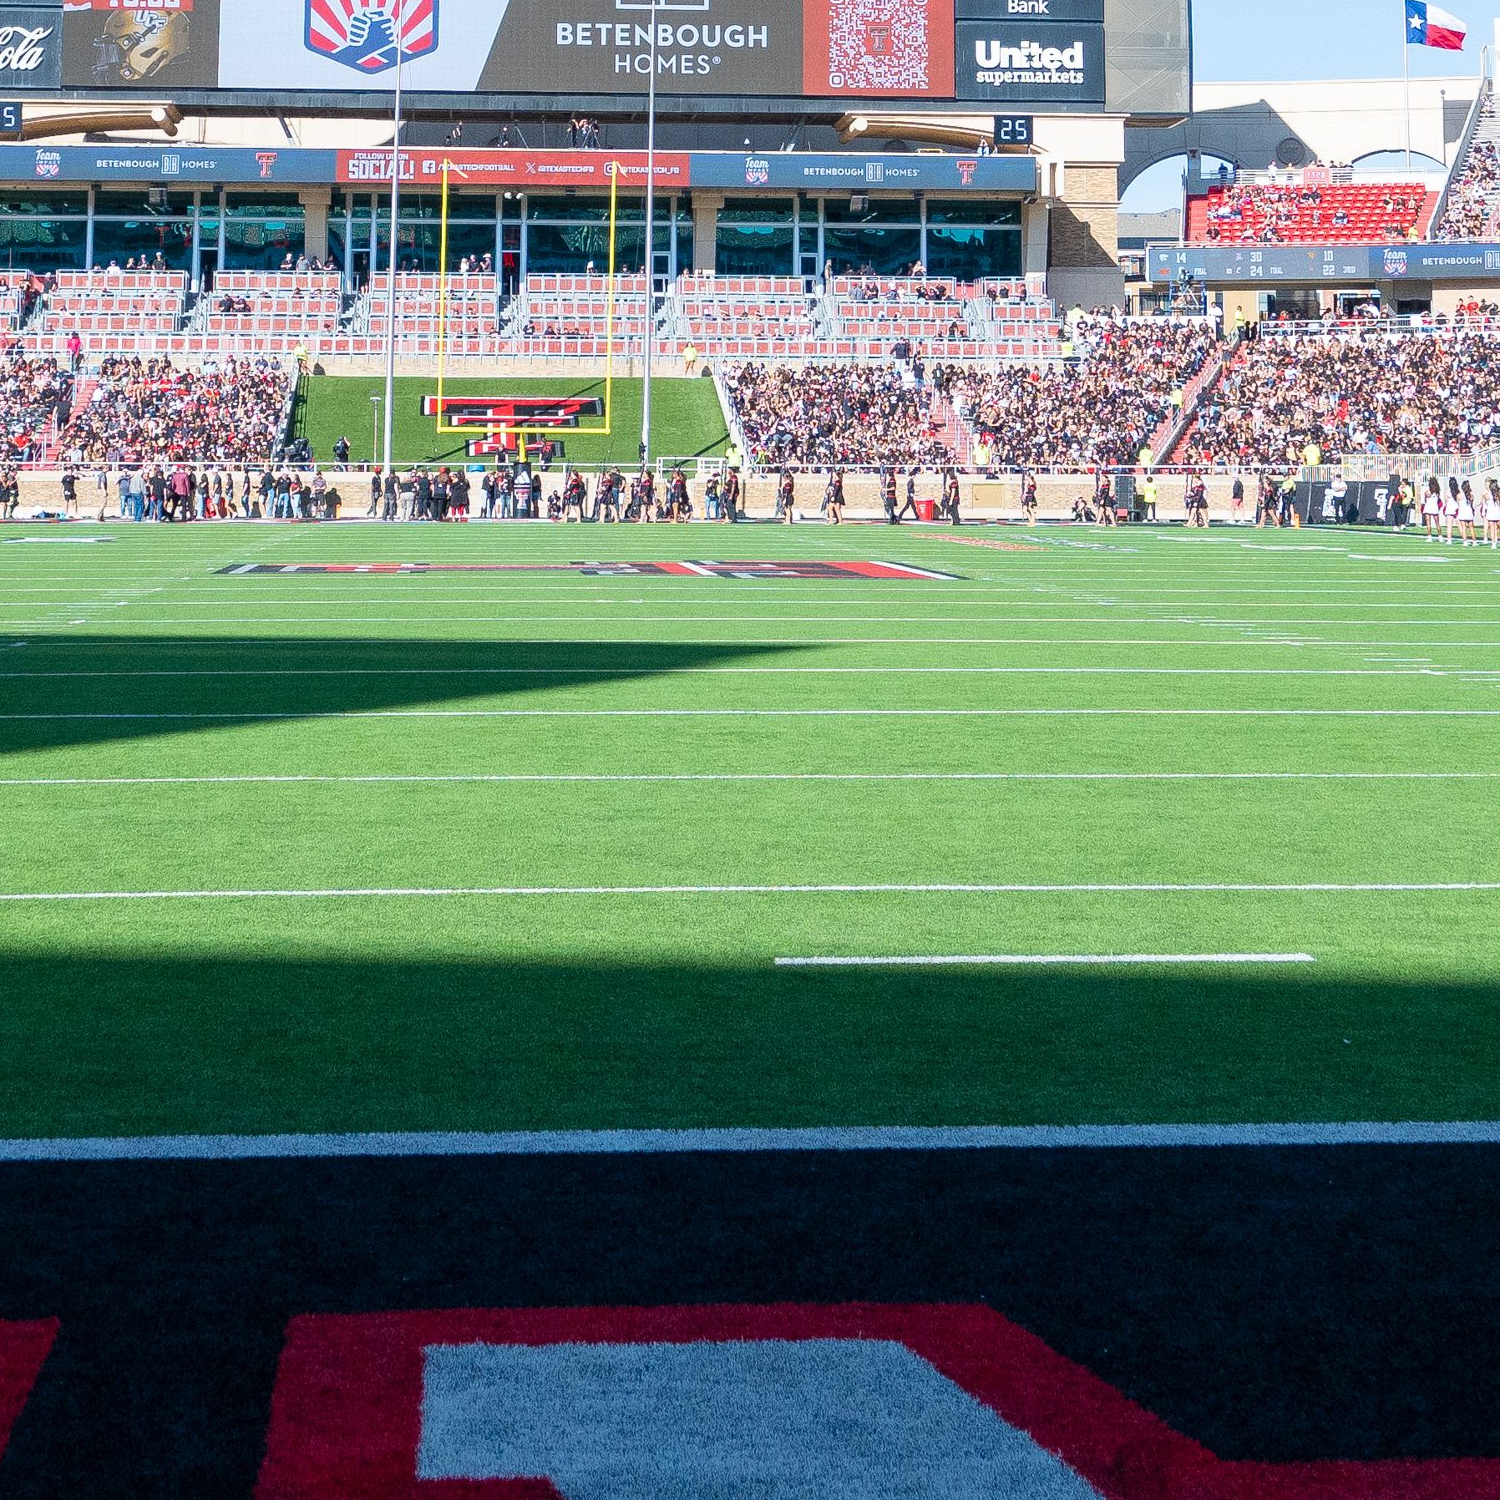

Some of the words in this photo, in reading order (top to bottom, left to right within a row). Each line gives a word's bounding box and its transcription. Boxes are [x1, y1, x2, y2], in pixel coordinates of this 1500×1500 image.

[556, 23, 768, 48] BETENBOUGH
[975, 40, 1084, 70] United
[976, 69, 1084, 87] supermarkets
[1000, 119, 1028, 140] 25
[96, 160, 159, 168] BETENBOUGH
[348, 160, 415, 179] SOCIAL!
[803, 167, 864, 176] BETENBOUGH
[1176, 252, 1187, 263] 14
[1422, 257, 1482, 266] BETENBOUGH
[1250, 266, 1263, 276] 24
